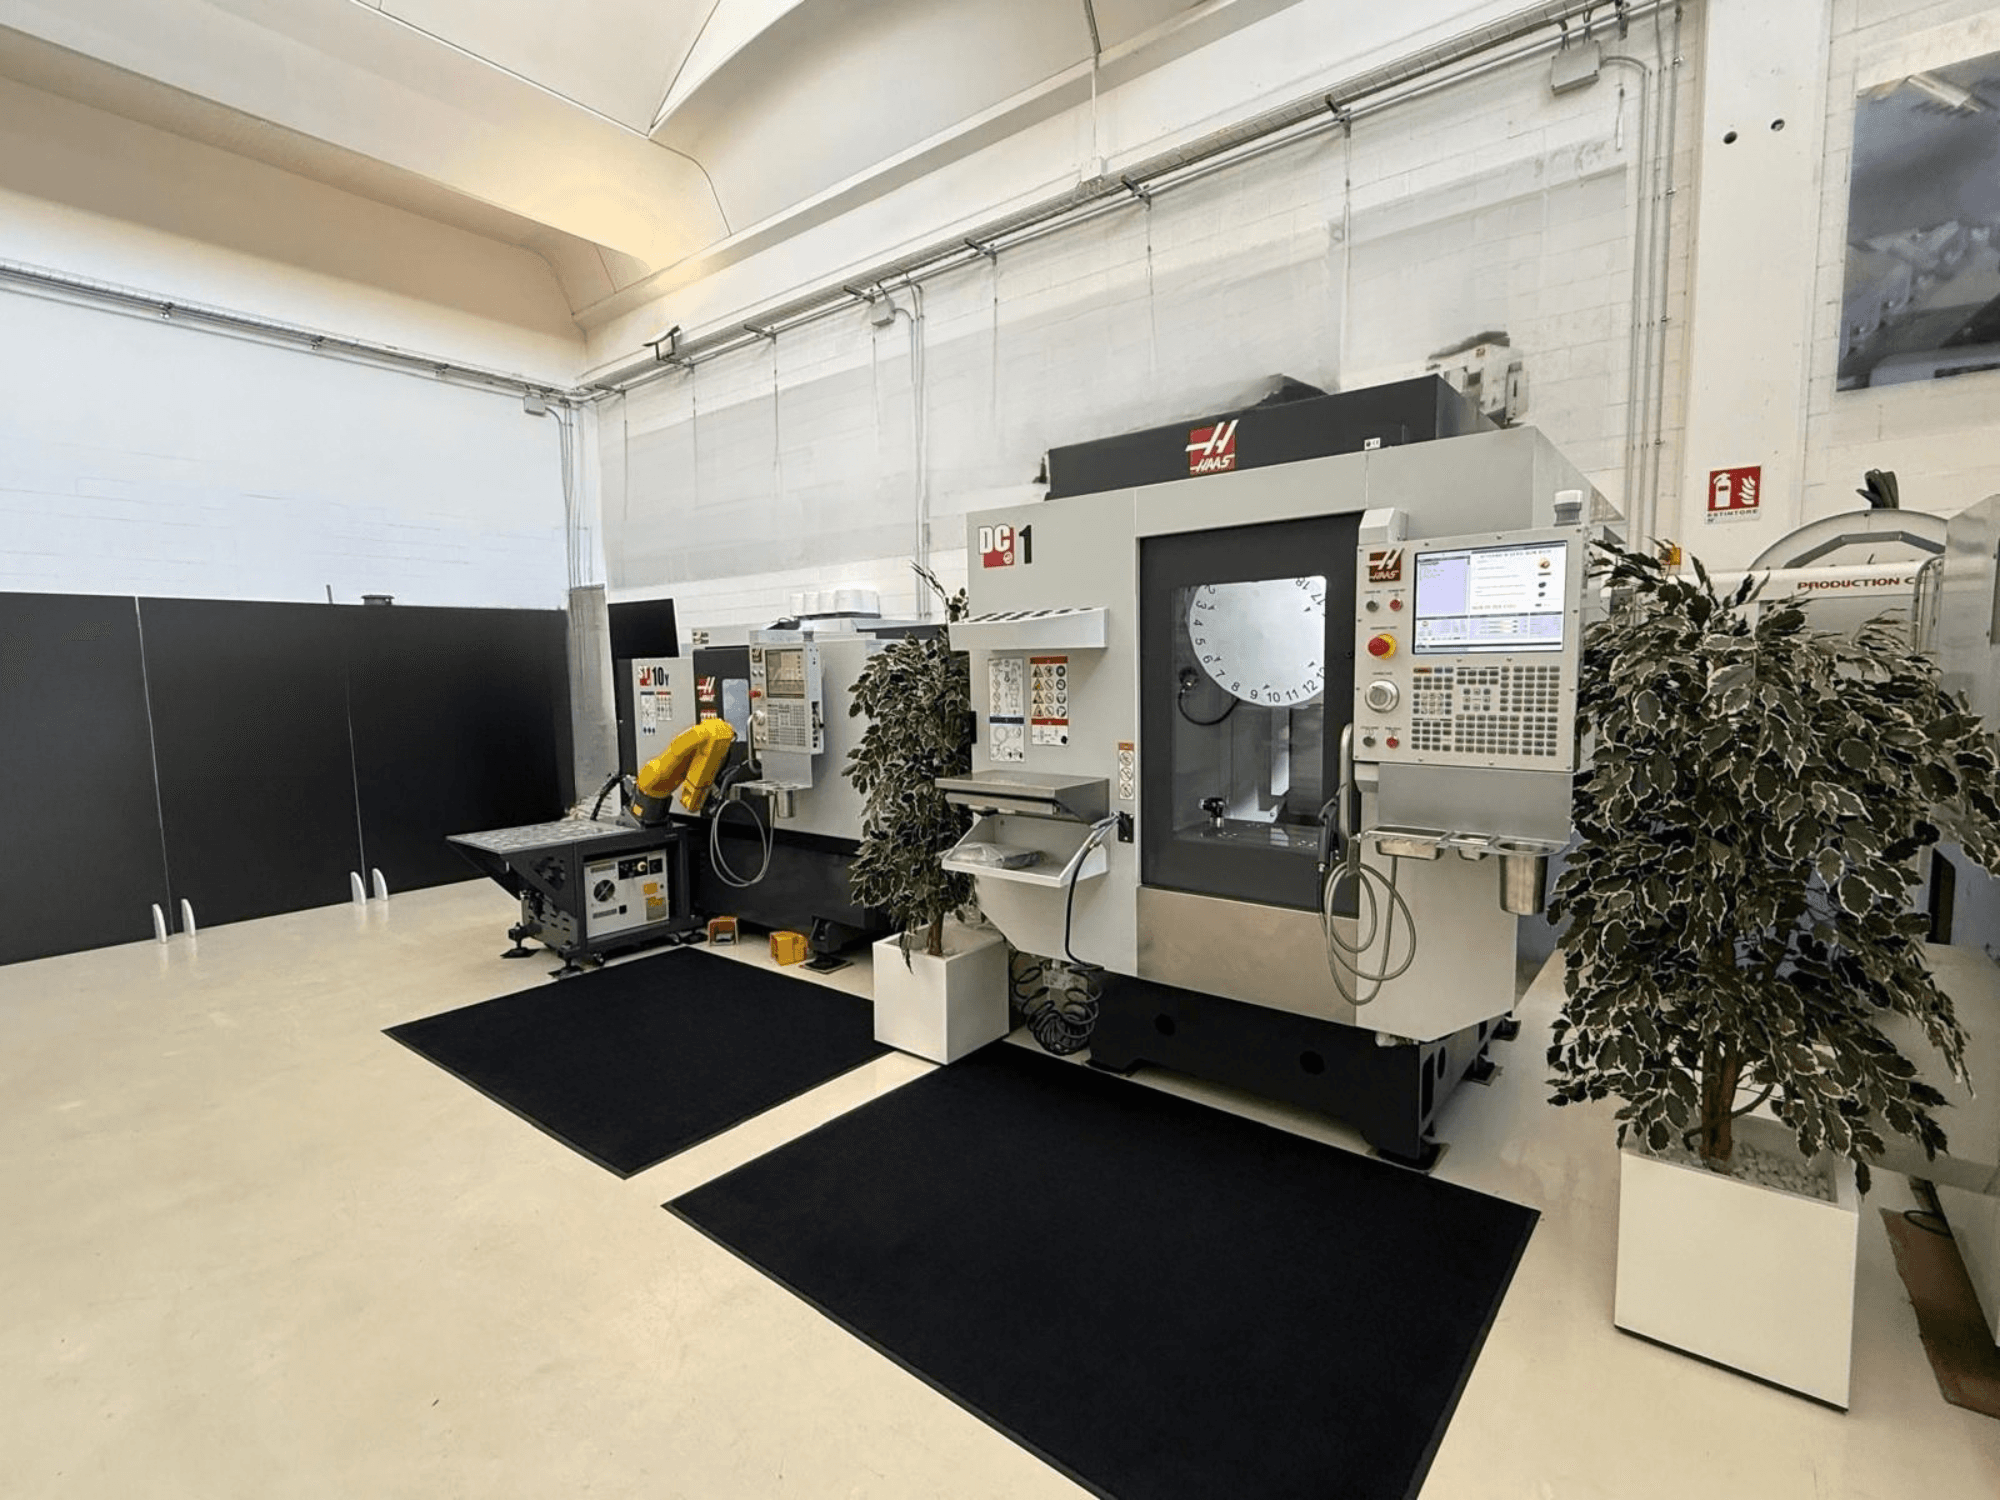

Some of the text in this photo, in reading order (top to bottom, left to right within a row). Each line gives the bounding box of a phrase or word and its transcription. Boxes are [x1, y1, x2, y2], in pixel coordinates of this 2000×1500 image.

[1190, 454, 1235, 474] HAAS
[978, 523, 1011, 555] DC
[1797, 577, 1900, 590] PRODUCTION
[1215, 669, 1226, 679] 7
[1231, 681, 1241, 692] 8
[1302, 679, 1318, 693] 12
[1250, 689, 1259, 700] 9
[1267, 691, 1281, 703] 10
[1285, 689, 1300, 701] 11
